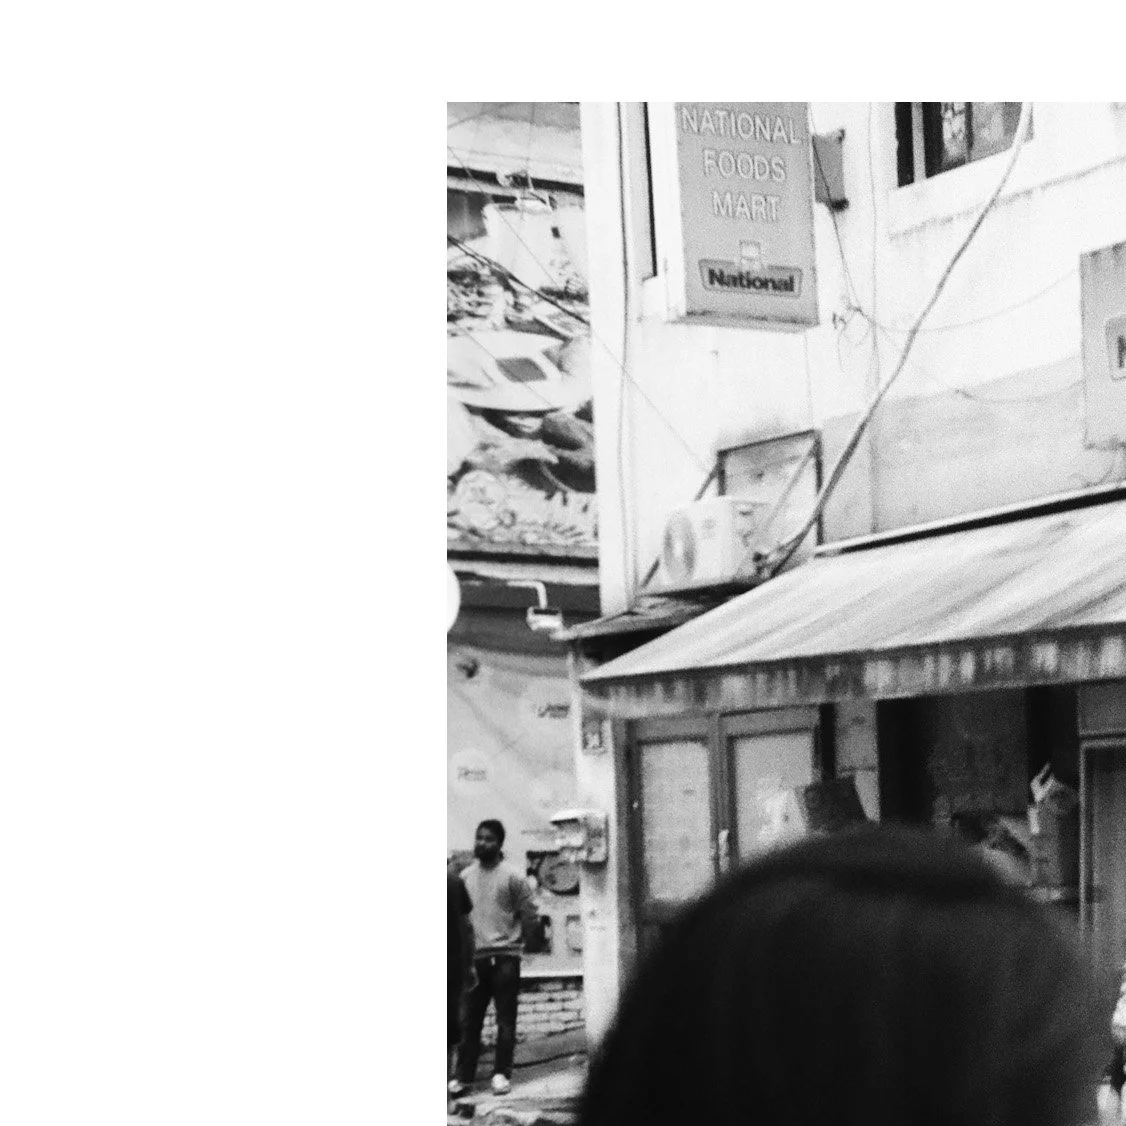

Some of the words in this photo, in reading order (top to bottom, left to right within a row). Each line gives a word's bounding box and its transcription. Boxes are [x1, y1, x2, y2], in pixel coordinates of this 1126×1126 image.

[681, 107, 802, 145] NATIONAL
[703, 148, 787, 183] FOODS
[712, 190, 780, 221] MART
[708, 267, 795, 293] National
